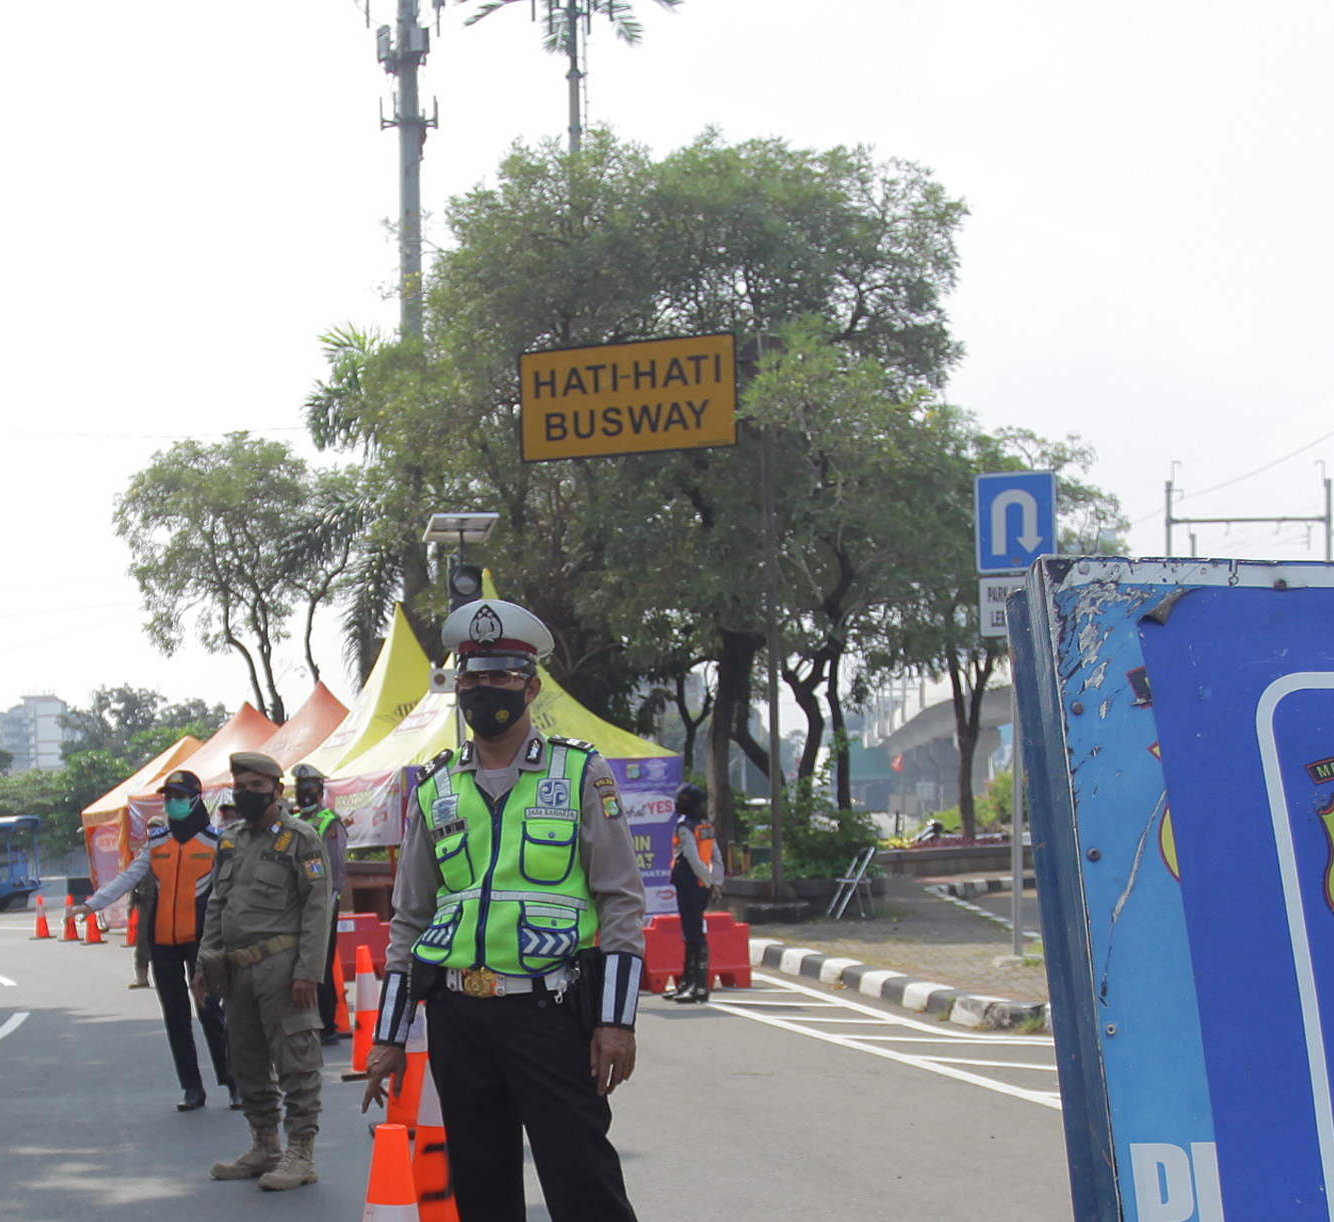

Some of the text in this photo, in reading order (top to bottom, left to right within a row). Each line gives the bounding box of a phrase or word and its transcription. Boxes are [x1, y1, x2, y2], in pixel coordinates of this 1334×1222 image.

[534, 354, 721, 399] HATI-HATI
[545, 399, 710, 442] BUSWAY
[647, 800, 673, 814] YES
